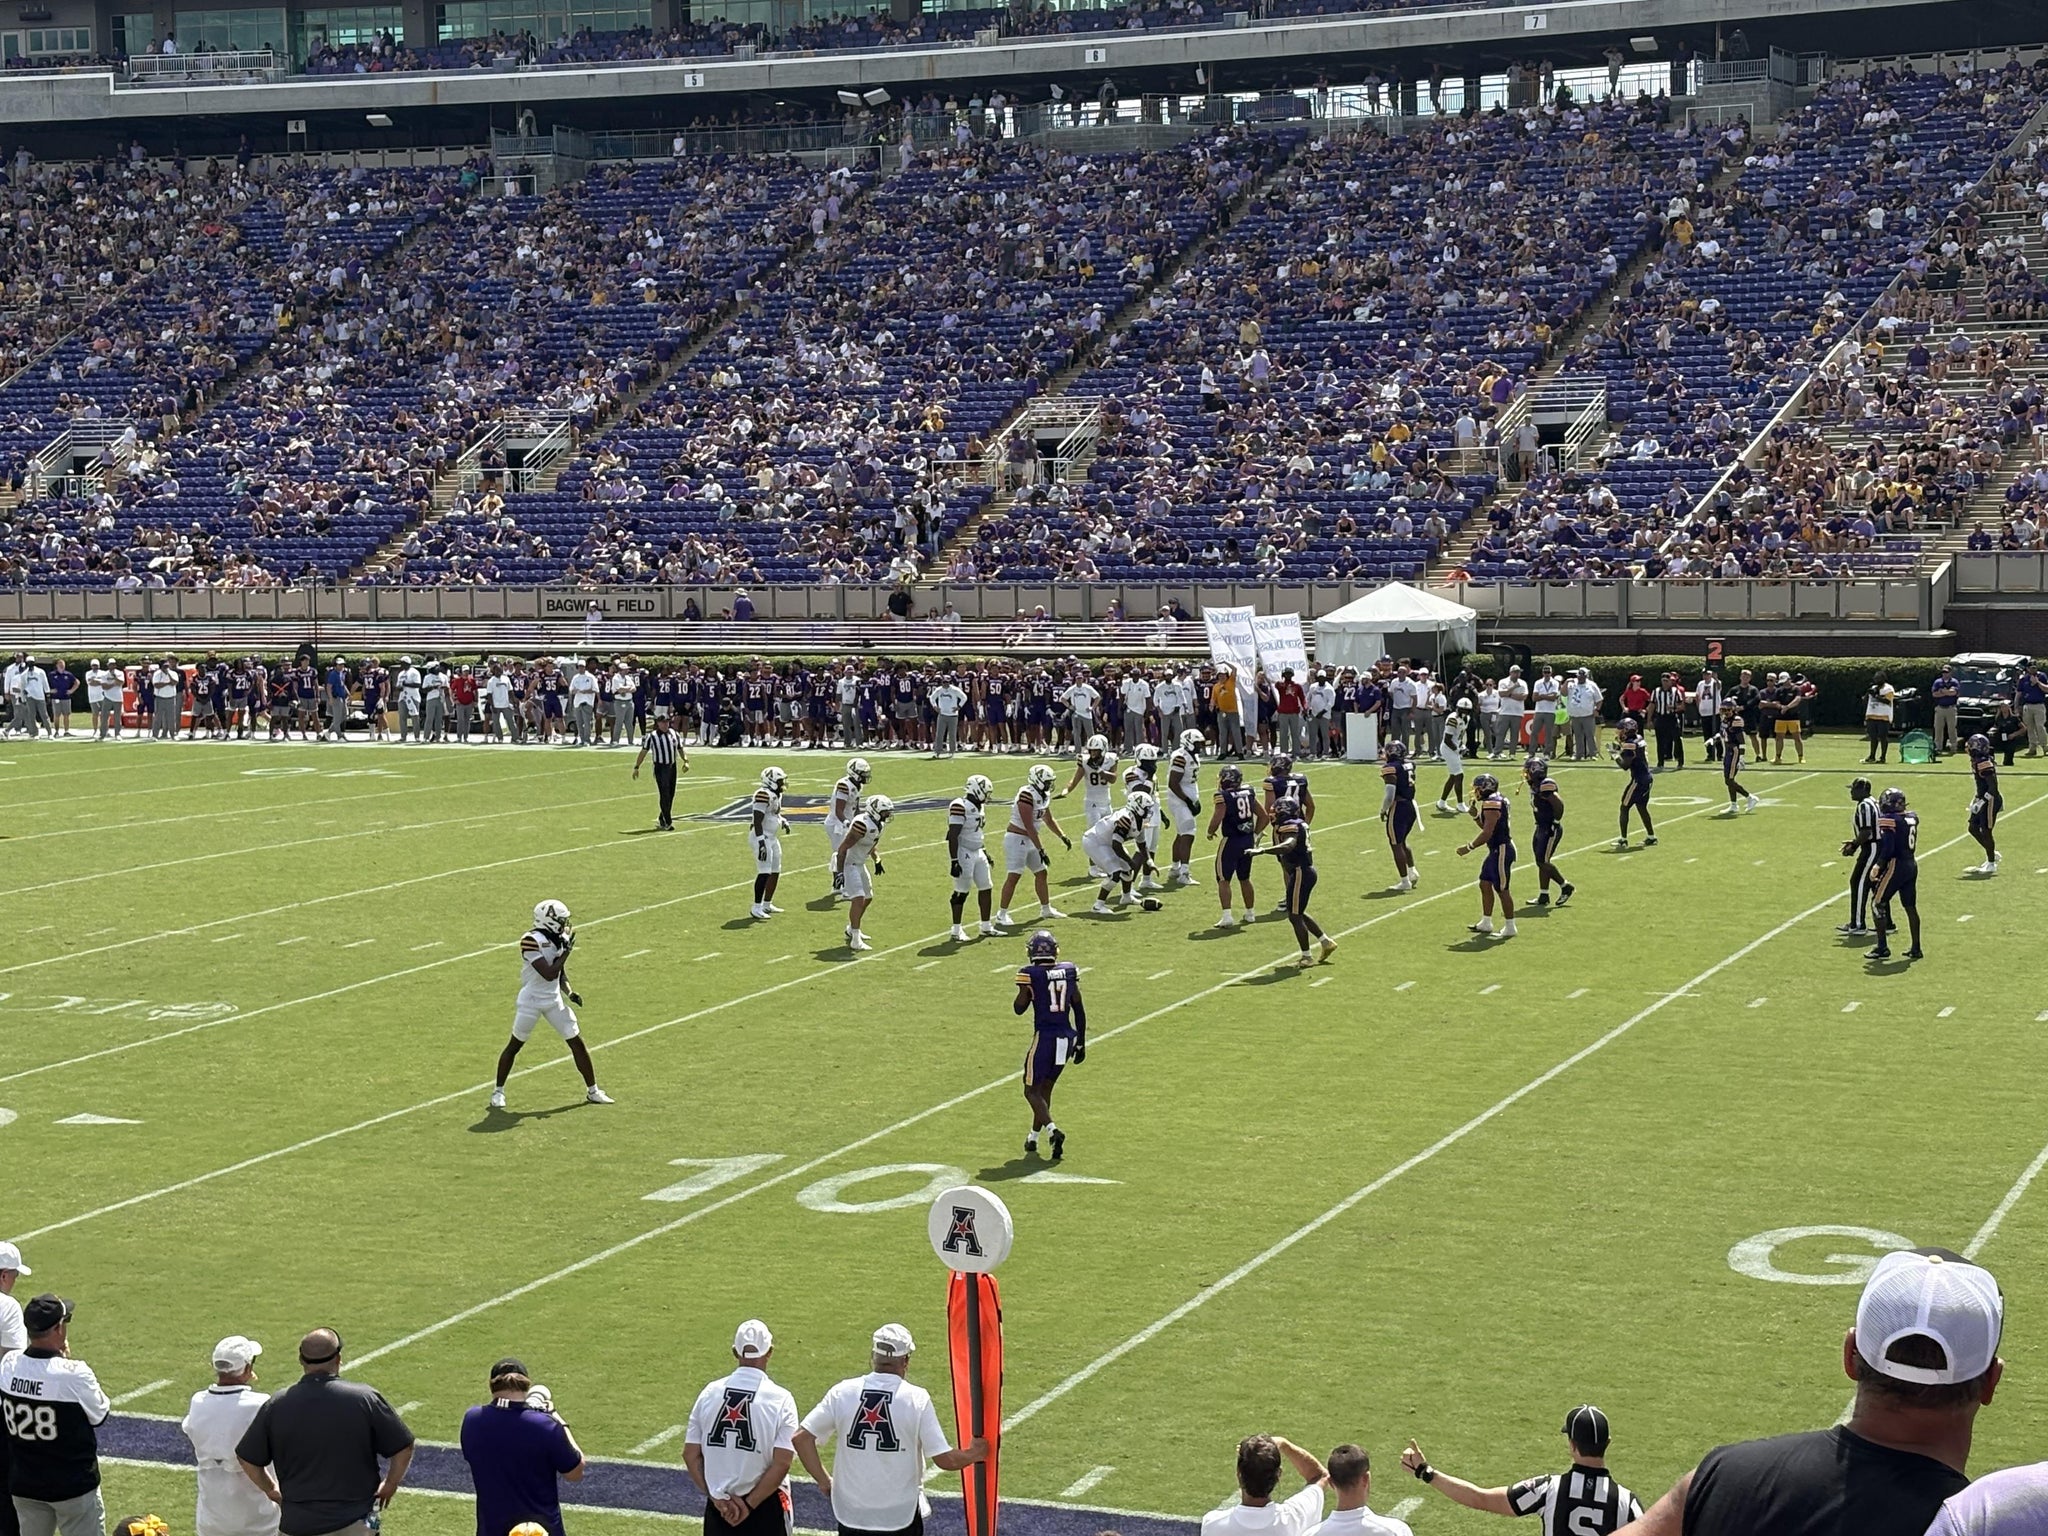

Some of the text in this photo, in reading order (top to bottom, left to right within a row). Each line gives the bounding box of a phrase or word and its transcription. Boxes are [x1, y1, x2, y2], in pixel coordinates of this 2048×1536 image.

[1532, 16, 1539, 29] 7
[1093, 50, 1099, 62] 6
[691, 75, 698, 86] 5
[294, 121, 300, 132] 4
[546, 599, 655, 612] BAGWLL FIELD
[1707, 642, 1723, 660] 2
[235, 677, 246, 690] 23
[303, 676, 312, 689] 11
[546, 680, 557, 692] 35
[880, 674, 891, 686] 66
[900, 680, 911, 693] 80
[197, 683, 209, 695] 25
[659, 682, 671, 694] 26
[678, 682, 689, 695] 10
[709, 685, 715, 698] 5
[726, 683, 737, 695] 23
[750, 686, 761, 699] 22
[785, 684, 796, 697] 81
[815, 686, 825, 697] 12
[864, 687, 870, 700] 4
[989, 682, 1001, 695] 50
[1204, 687, 1210, 699] 0
[1344, 686, 1356, 701] 22
[1236, 795, 1252, 820] 91
[545, 904, 558, 918] A
[1048, 979, 1068, 1013] 17
[942, 1204, 984, 1259] A
[10, 1376, 44, 1396] BOONE
[3, 1398, 58, 1441] 828
[706, 1387, 758, 1452] A
[846, 1388, 901, 1452] A
